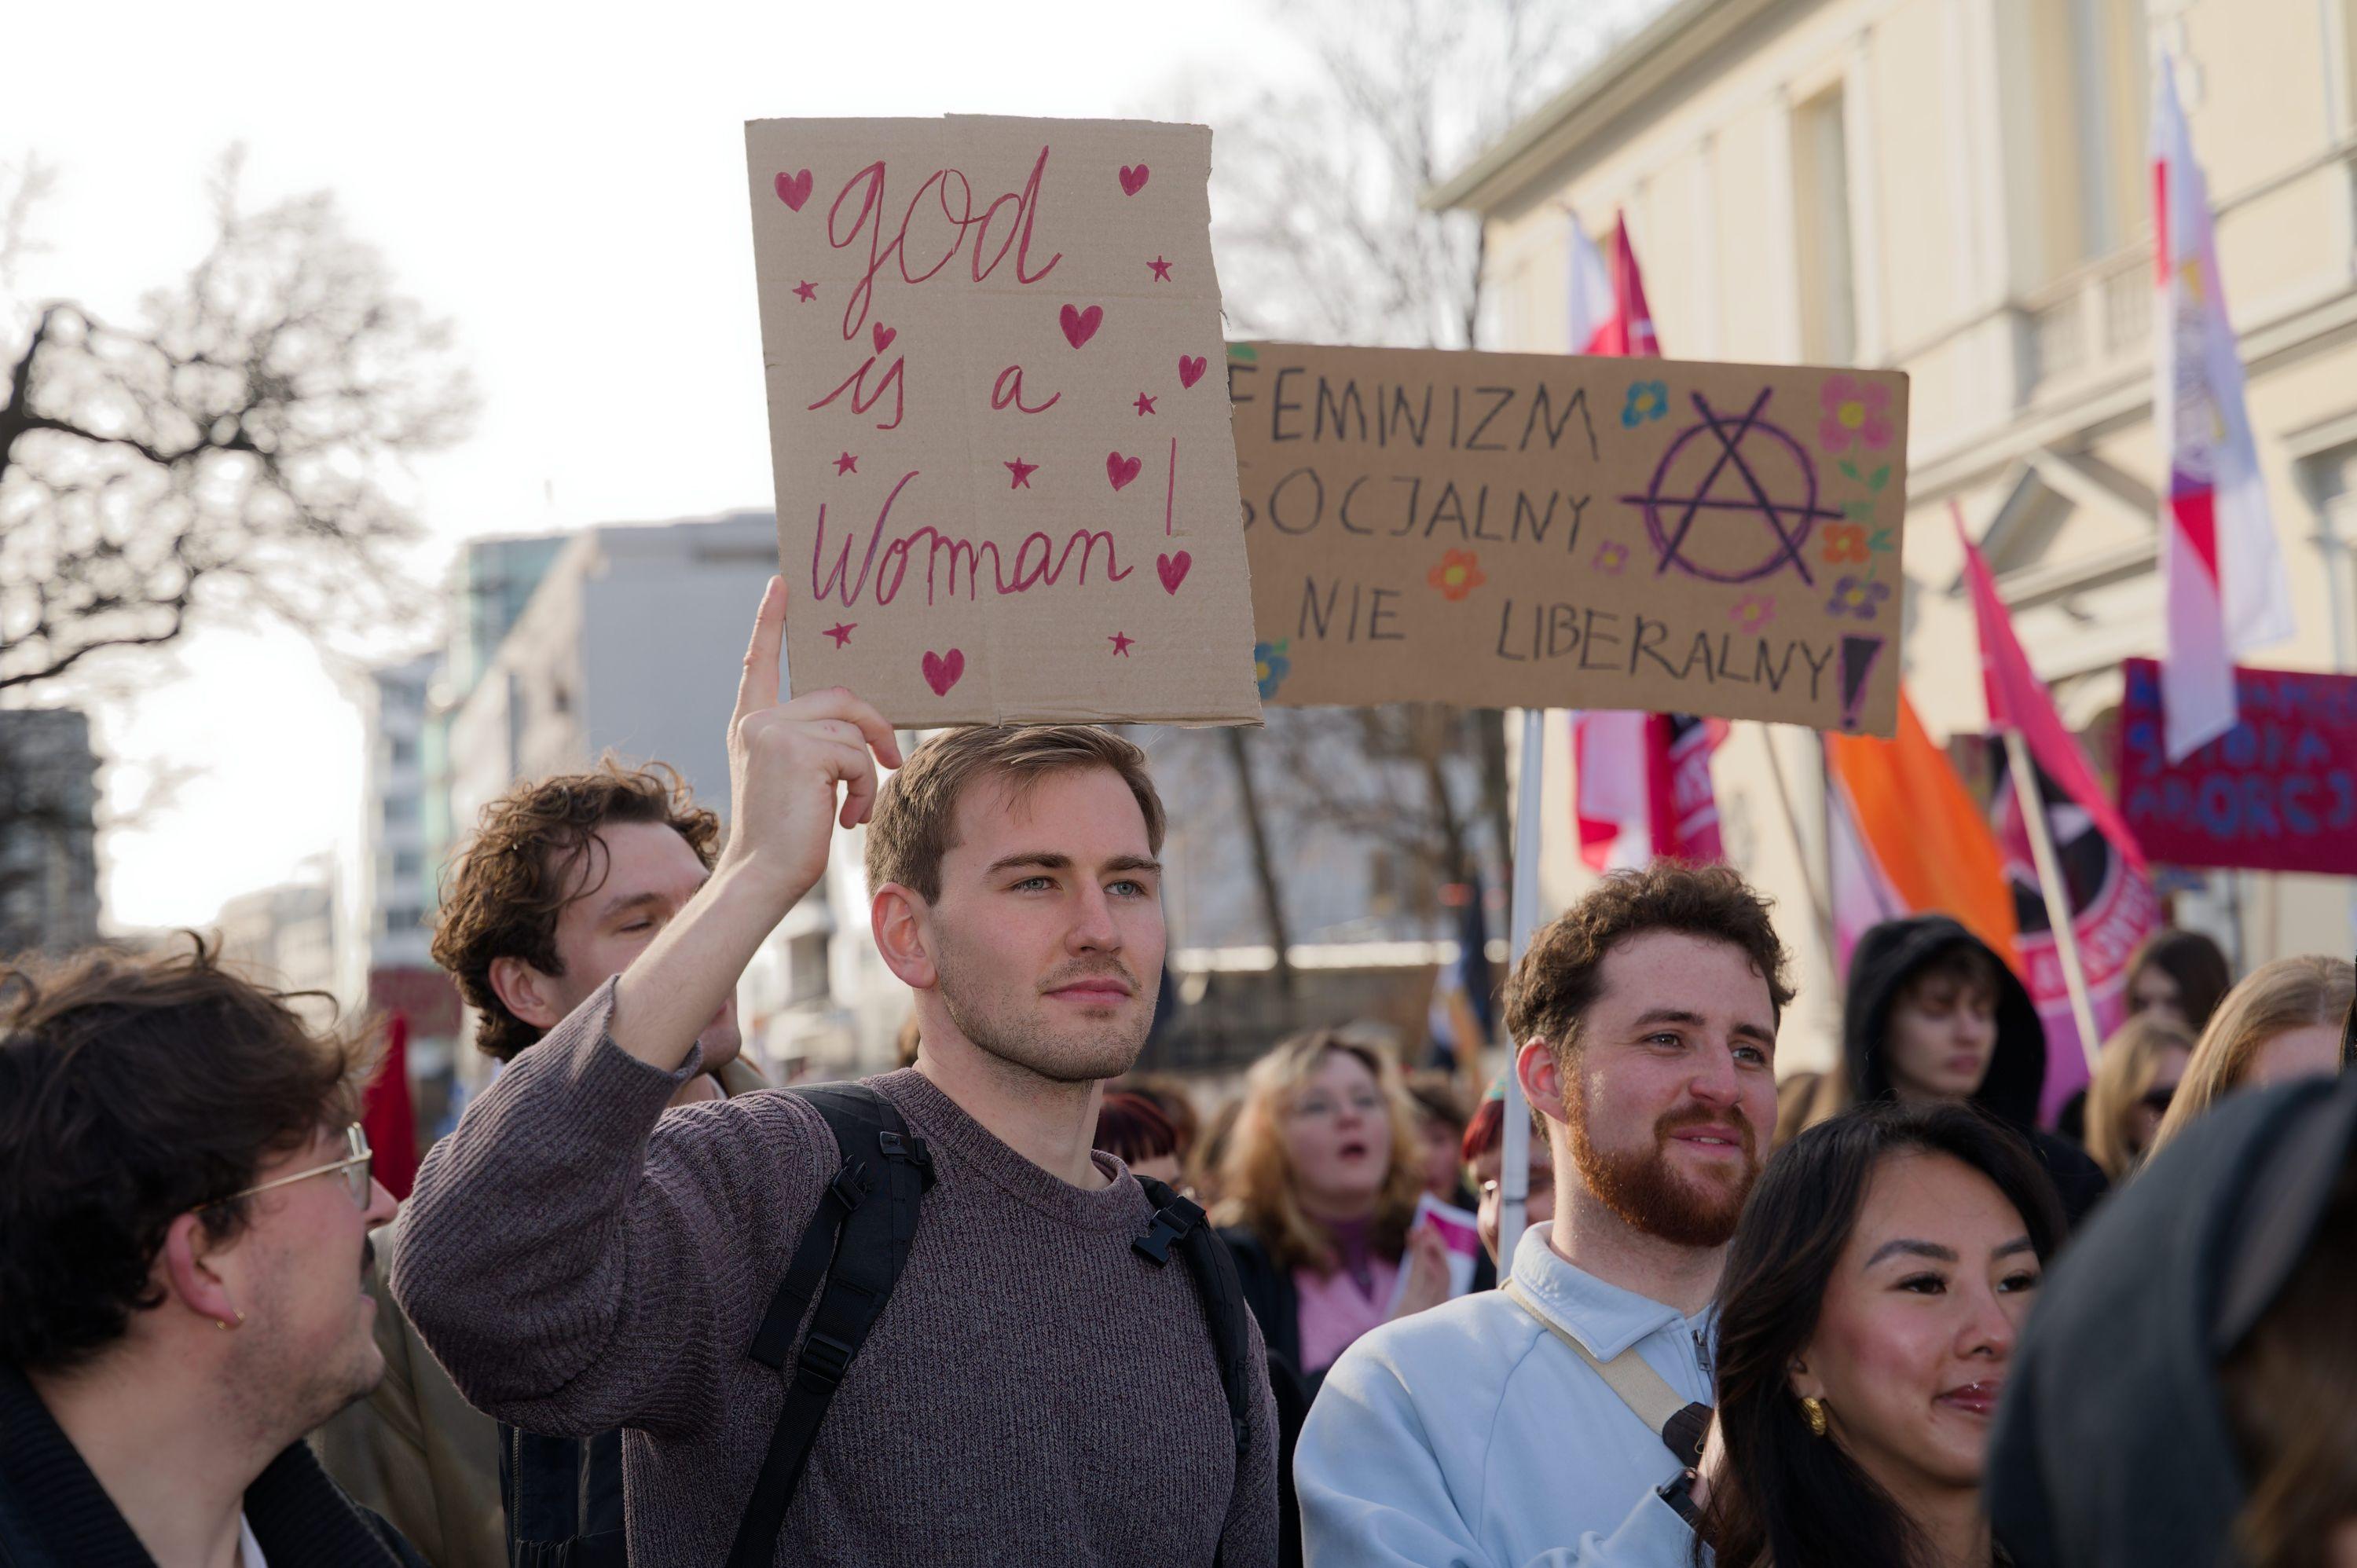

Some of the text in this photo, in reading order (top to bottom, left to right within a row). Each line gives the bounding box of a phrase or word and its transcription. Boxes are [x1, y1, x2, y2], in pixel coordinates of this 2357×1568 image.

[828, 146, 1062, 341] god
[808, 355, 1061, 430] is a
[1230, 365, 1599, 461] FEMINIZM
[1299, 577, 1882, 729] NIE LIBERALNY!
